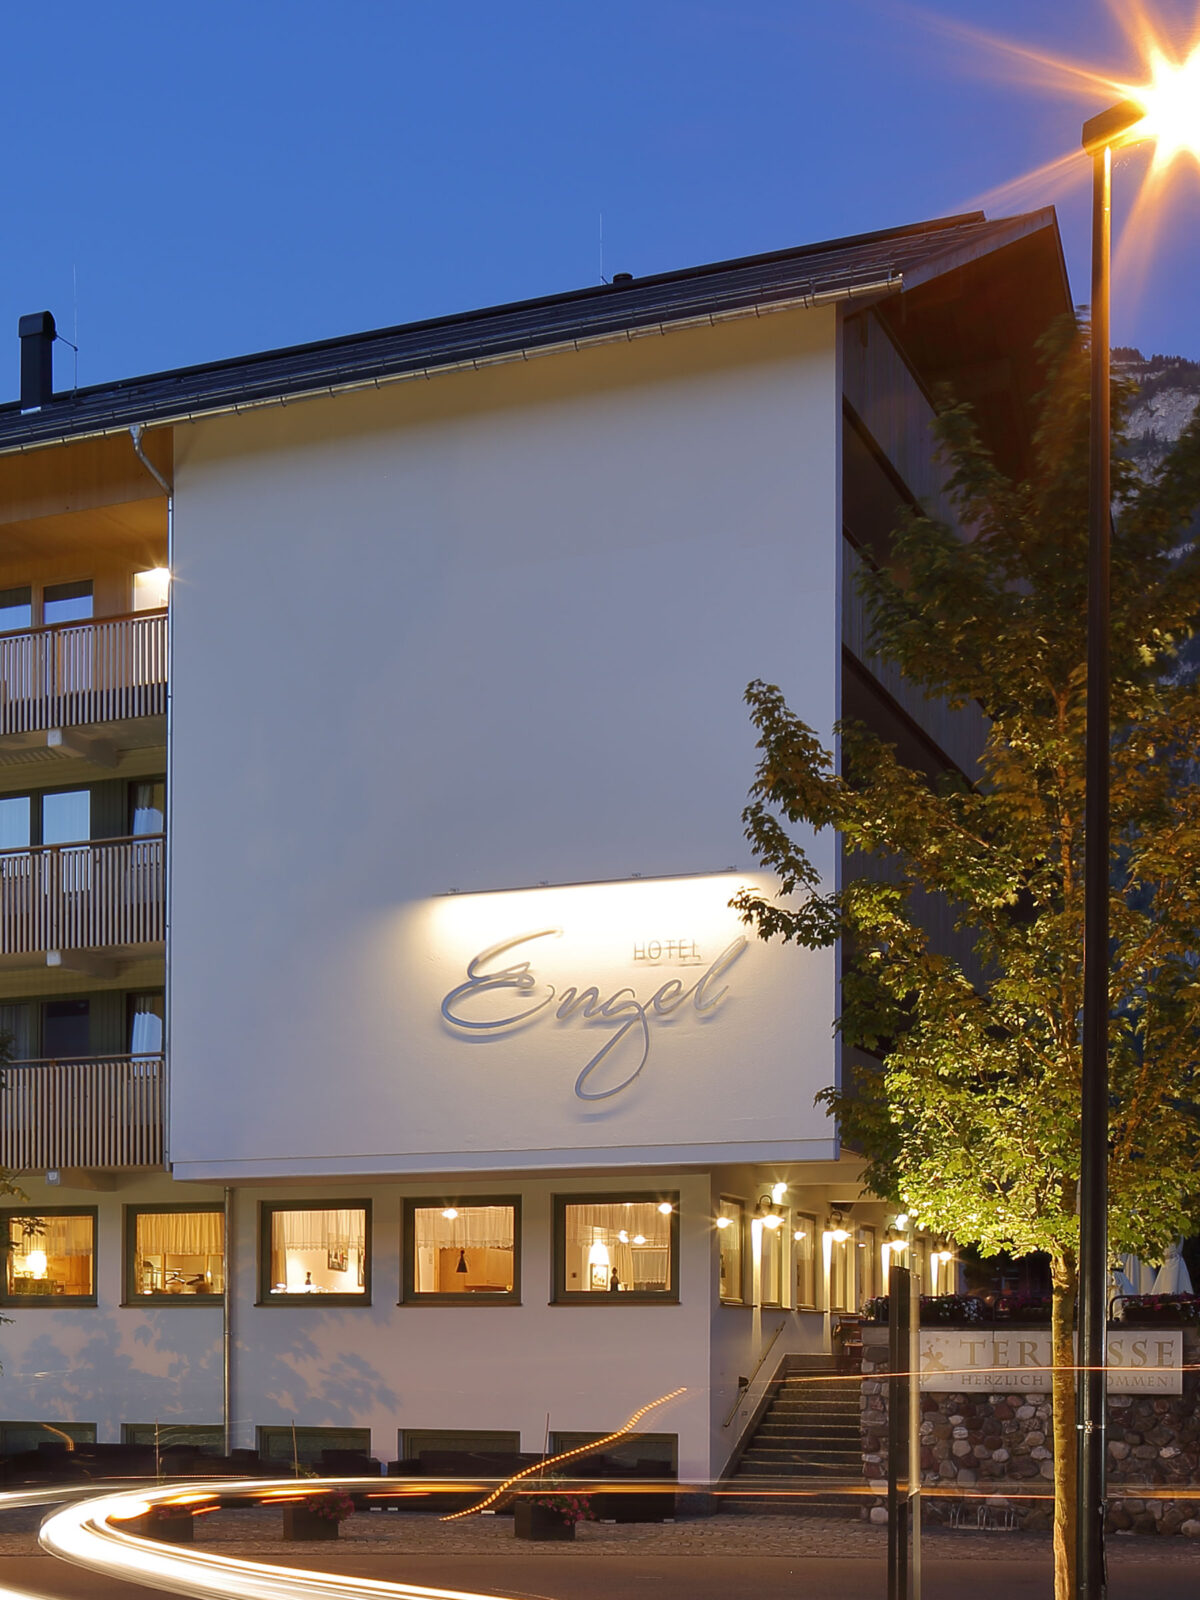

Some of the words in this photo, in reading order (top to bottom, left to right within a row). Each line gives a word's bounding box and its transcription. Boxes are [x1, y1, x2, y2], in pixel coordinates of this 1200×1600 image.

[633, 938, 701, 961] HOTEL
[441, 928, 748, 1100] Engel
[959, 1338, 1175, 1368] TERSSE
[961, 1374, 1044, 1386] HERZLICH
